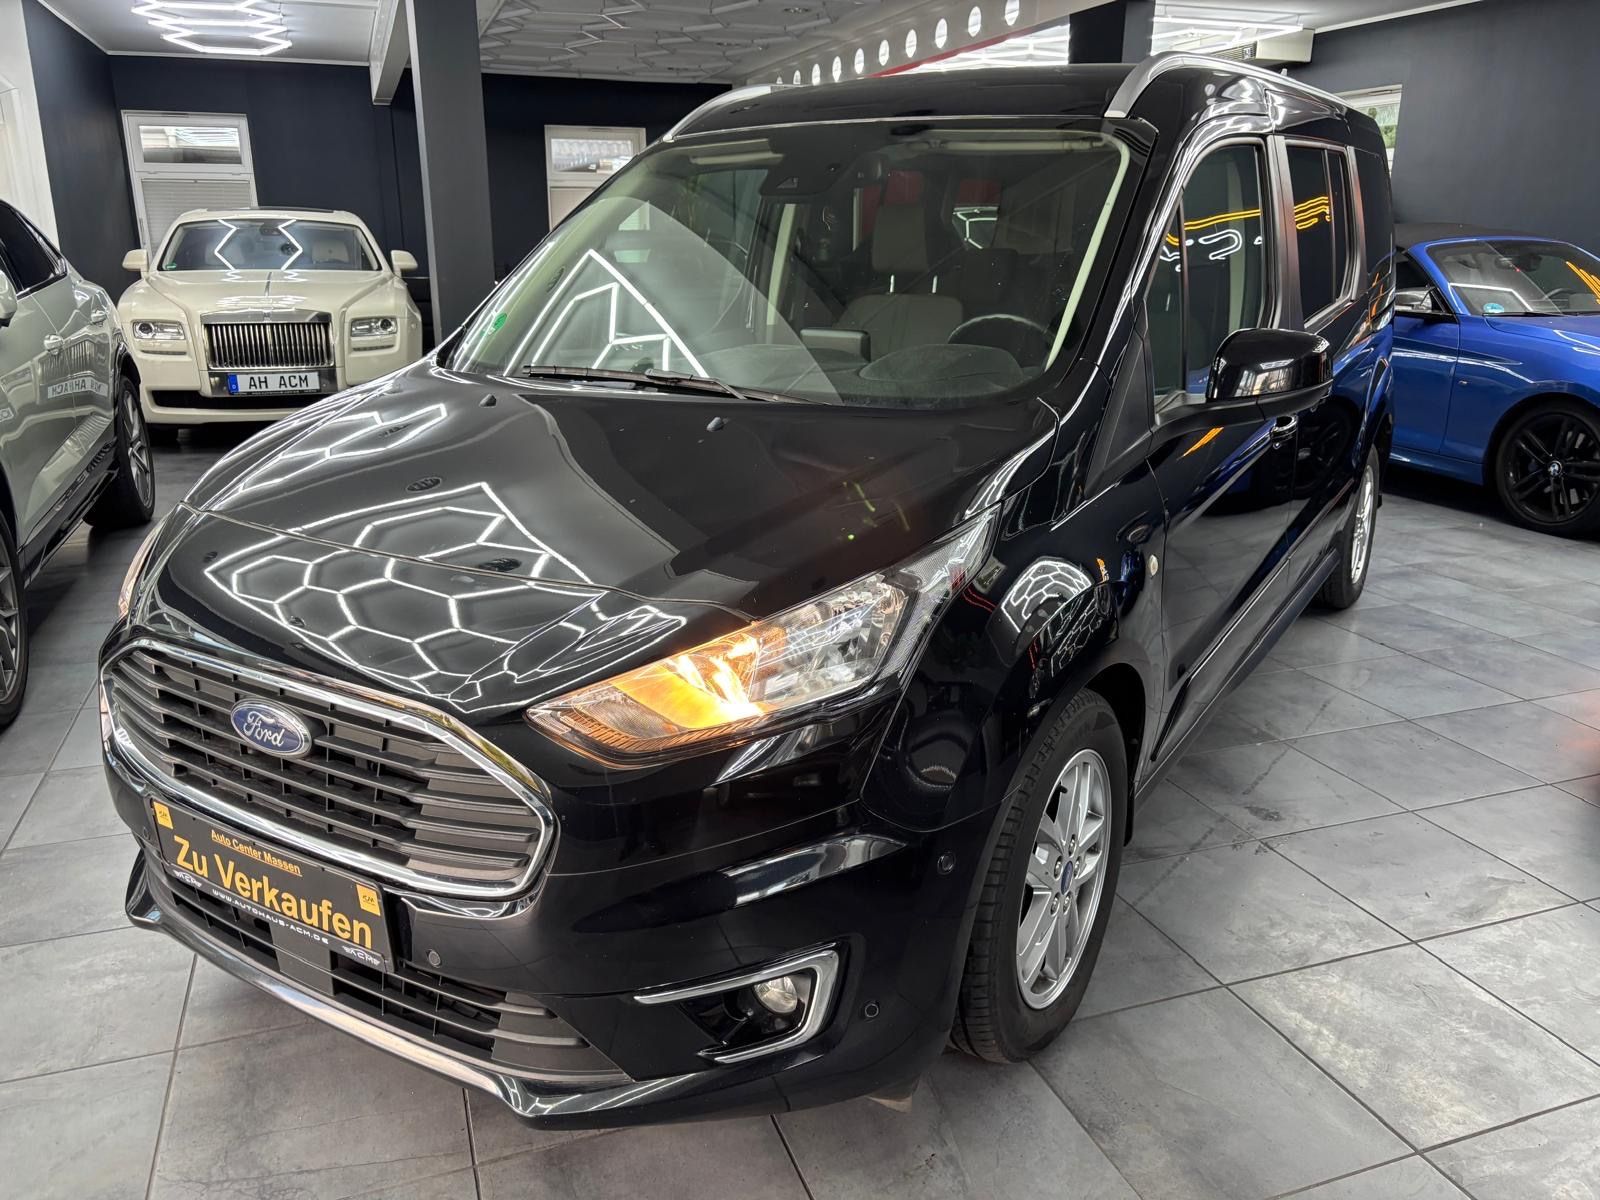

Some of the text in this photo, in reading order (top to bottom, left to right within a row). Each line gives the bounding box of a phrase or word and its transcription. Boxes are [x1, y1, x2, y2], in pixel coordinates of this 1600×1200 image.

[248, 374, 309, 390] AH ACM
[243, 710, 286, 747] Ford
[211, 829, 302, 876] Auto Center Massen
[173, 834, 373, 950] Zu Verkaufen
